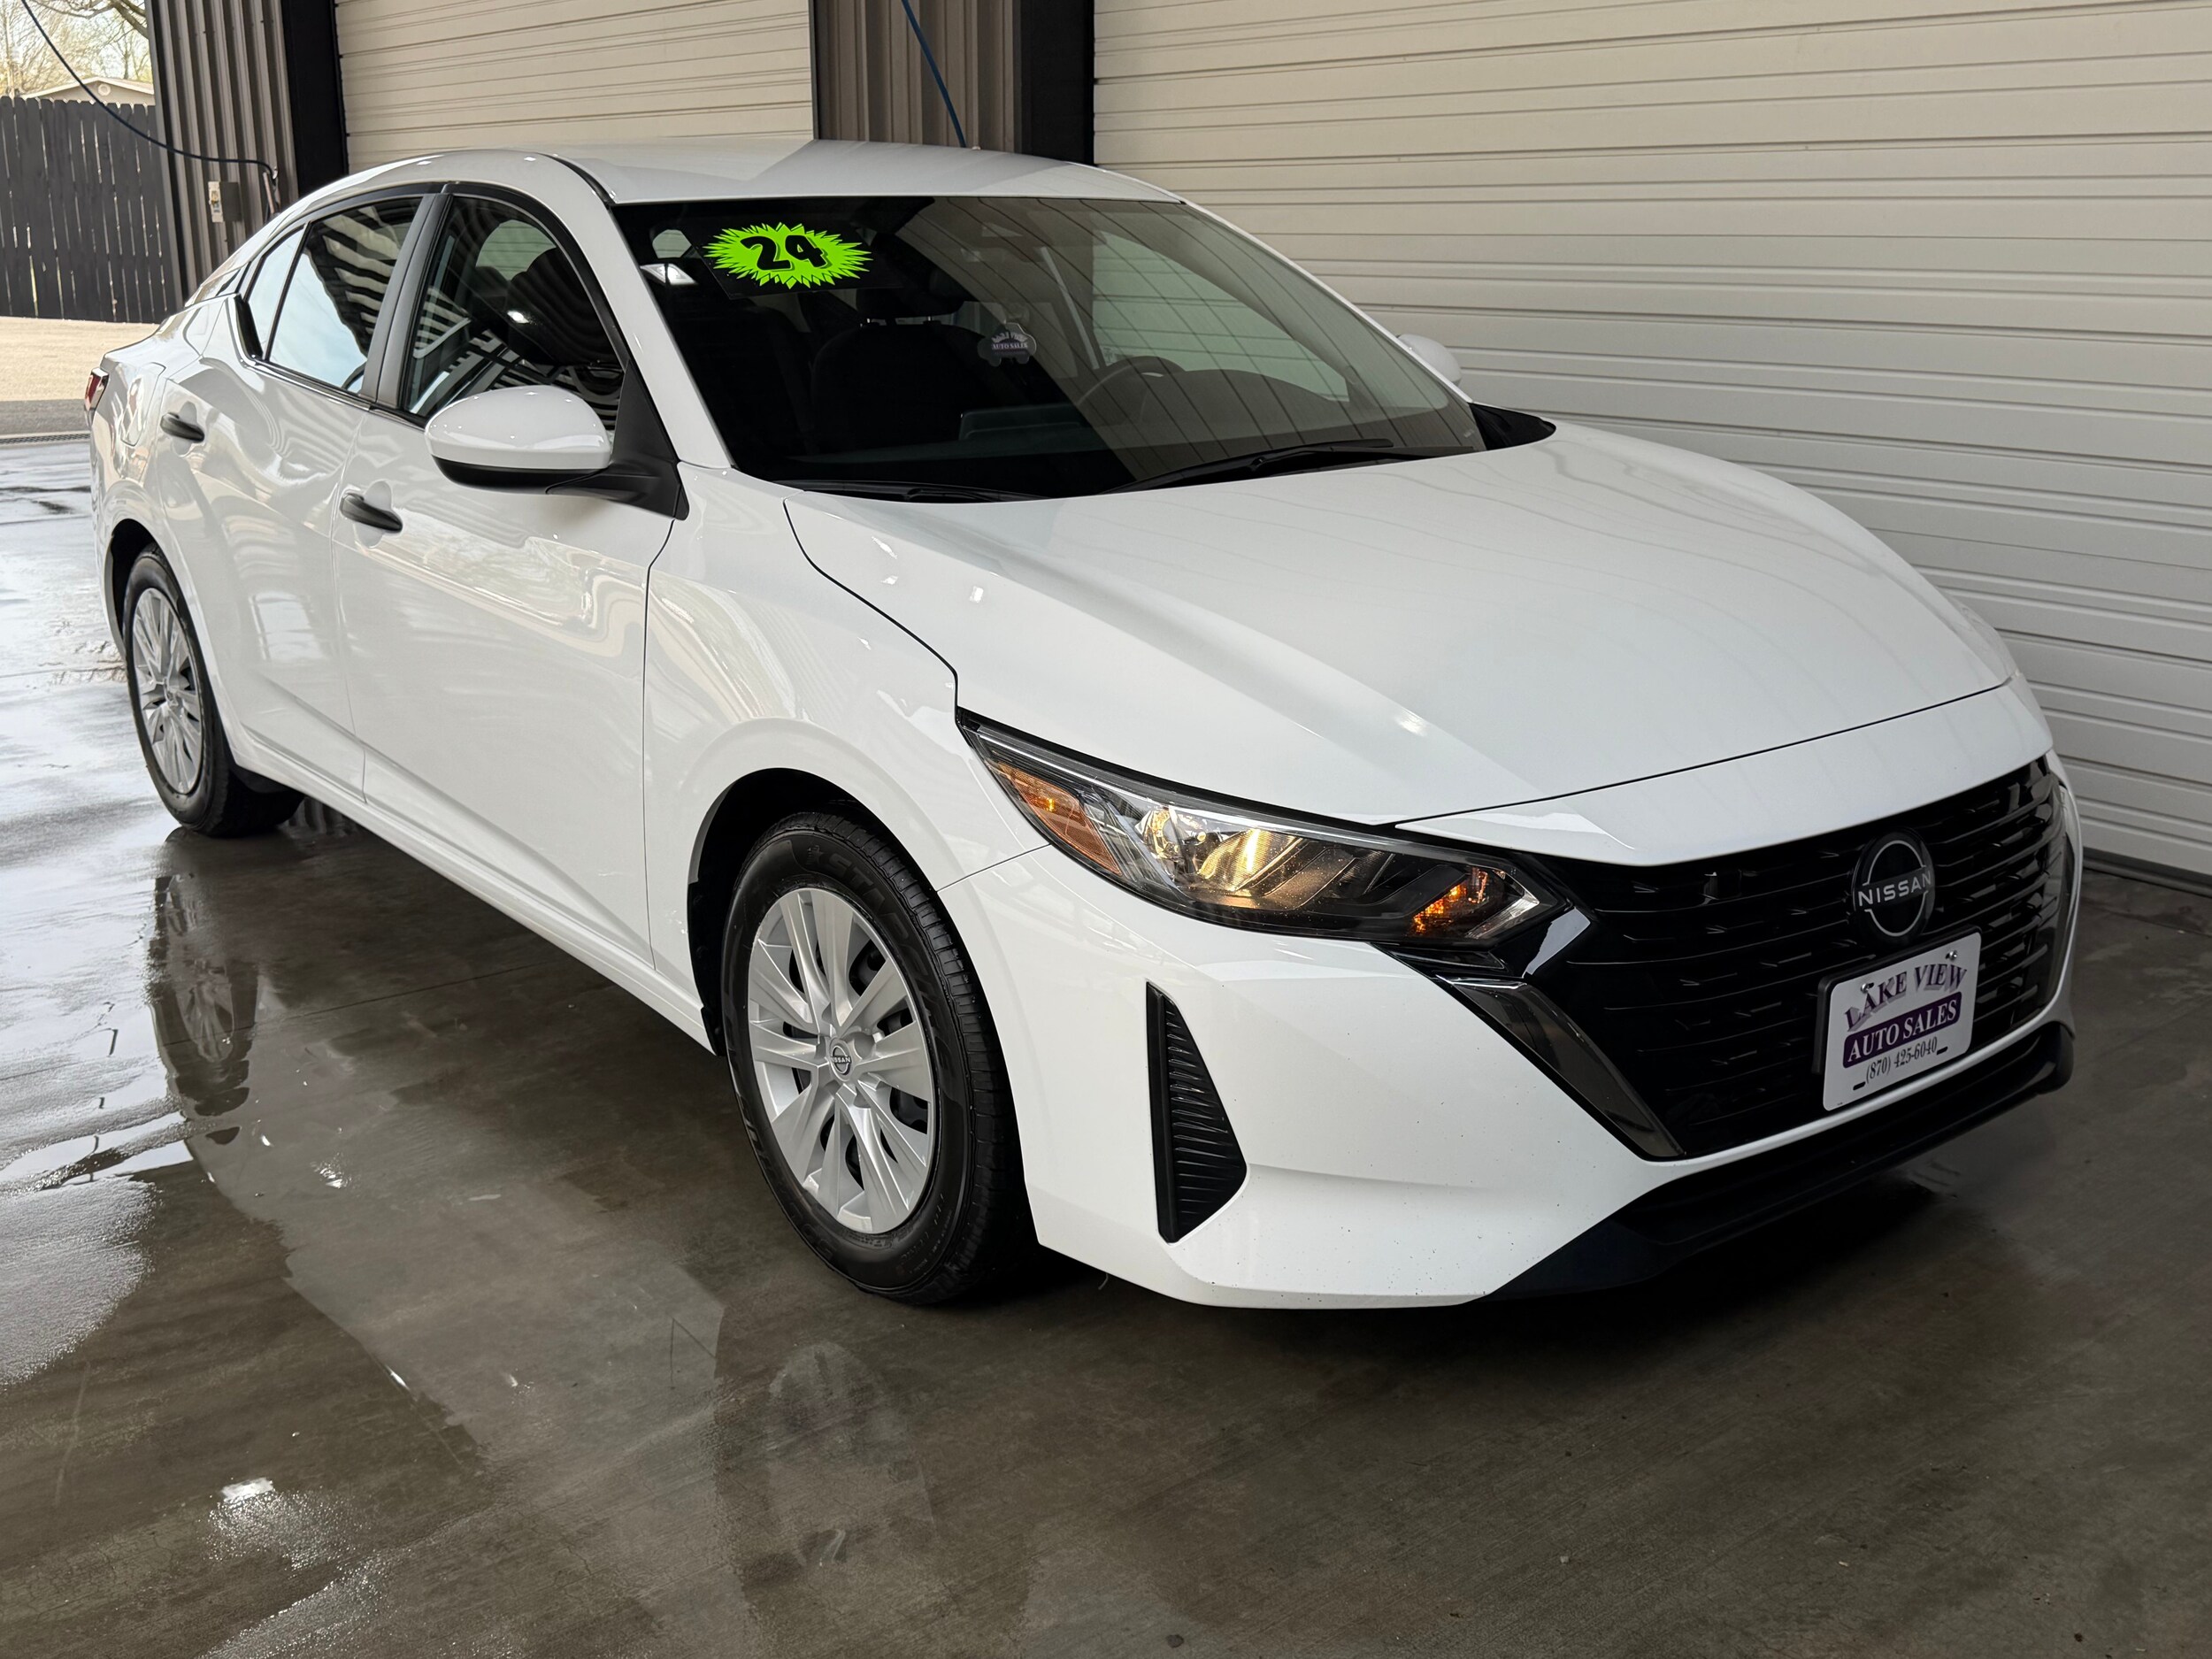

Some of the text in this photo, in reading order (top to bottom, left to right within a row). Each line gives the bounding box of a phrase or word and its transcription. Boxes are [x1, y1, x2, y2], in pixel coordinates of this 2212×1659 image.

[740, 234, 830, 271] 24
[1858, 871, 1932, 907] NISSAN
[1844, 964, 1967, 1032] LAKE VIEW
[1847, 999, 1957, 1063] AUTO SALES
[1865, 1036, 1938, 1083] (870) 425-6040
